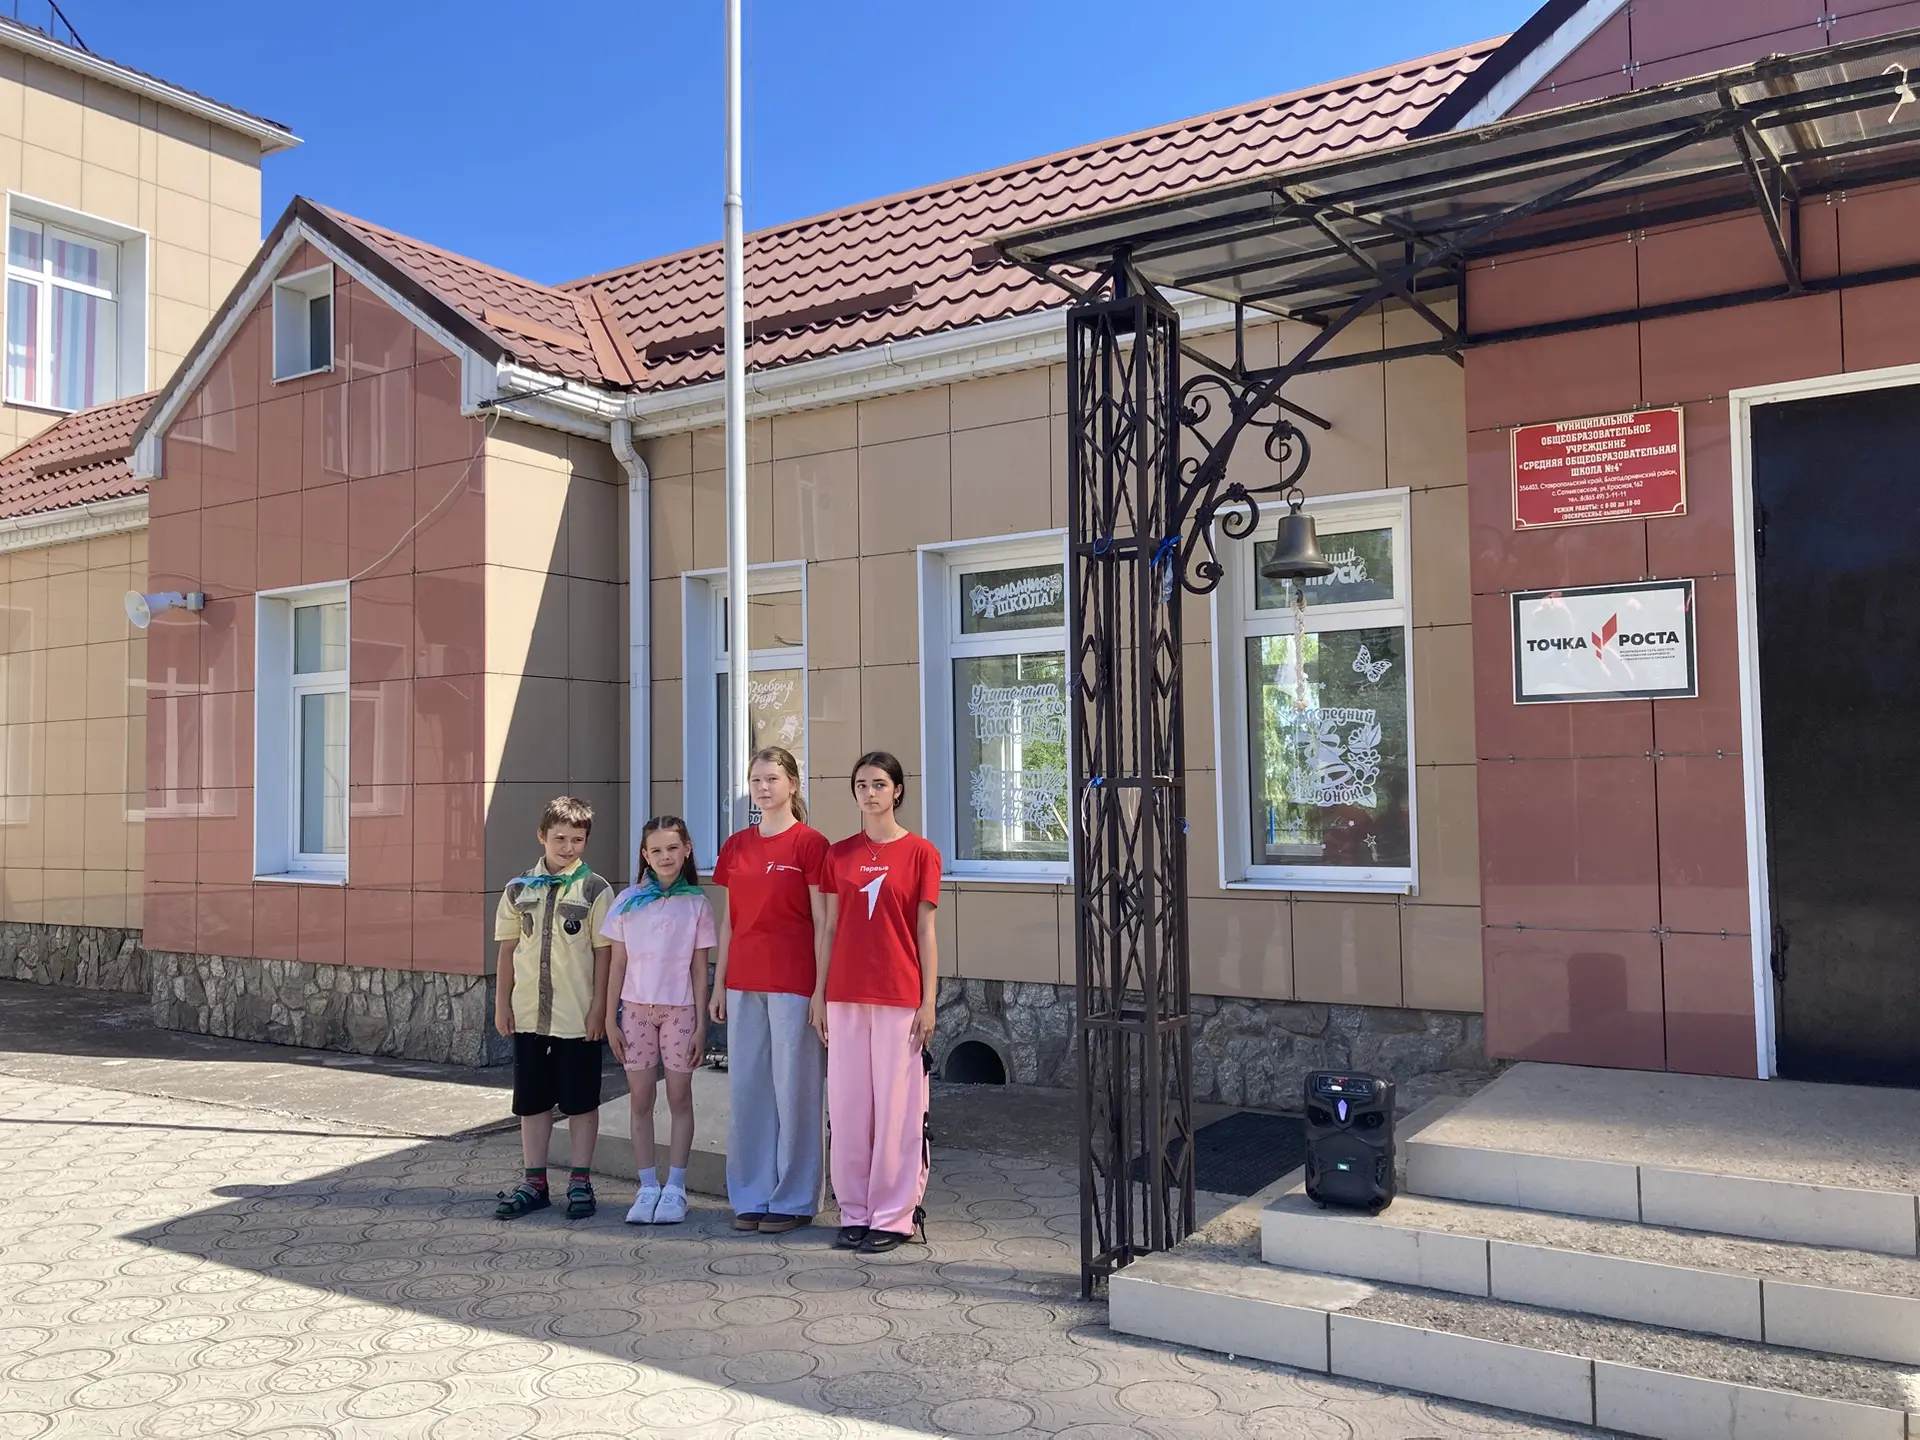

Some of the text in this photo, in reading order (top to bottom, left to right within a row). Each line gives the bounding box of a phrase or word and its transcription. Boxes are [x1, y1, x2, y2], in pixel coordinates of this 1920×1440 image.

[1556, 415, 1634, 432] МУНИЦИПАЛЬНОЕ
[1541, 424, 1651, 446] ОБЩЕОБРАЗОВАТЕЛЬНОЕ
[1565, 439, 1626, 454] УЧРЕЖДЕНИЕ
[1565, 444, 1677, 466] ОБЩЕОБРАЗОВАТЕЛЬНАЯ
[1571, 464, 1602, 477] ШКОЛА
[1540, 479, 1587, 489] Ставропольский
[1633, 480, 1643, 488] 162
[1606, 490, 1627, 499] 3-11-11
[1553, 505, 1574, 514] РЕЖИМ
[997, 588, 1055, 615] ШКОЛА!
[1526, 631, 1679, 652] ТОЧКА РОСТА
[860, 865, 889, 873] Первые
